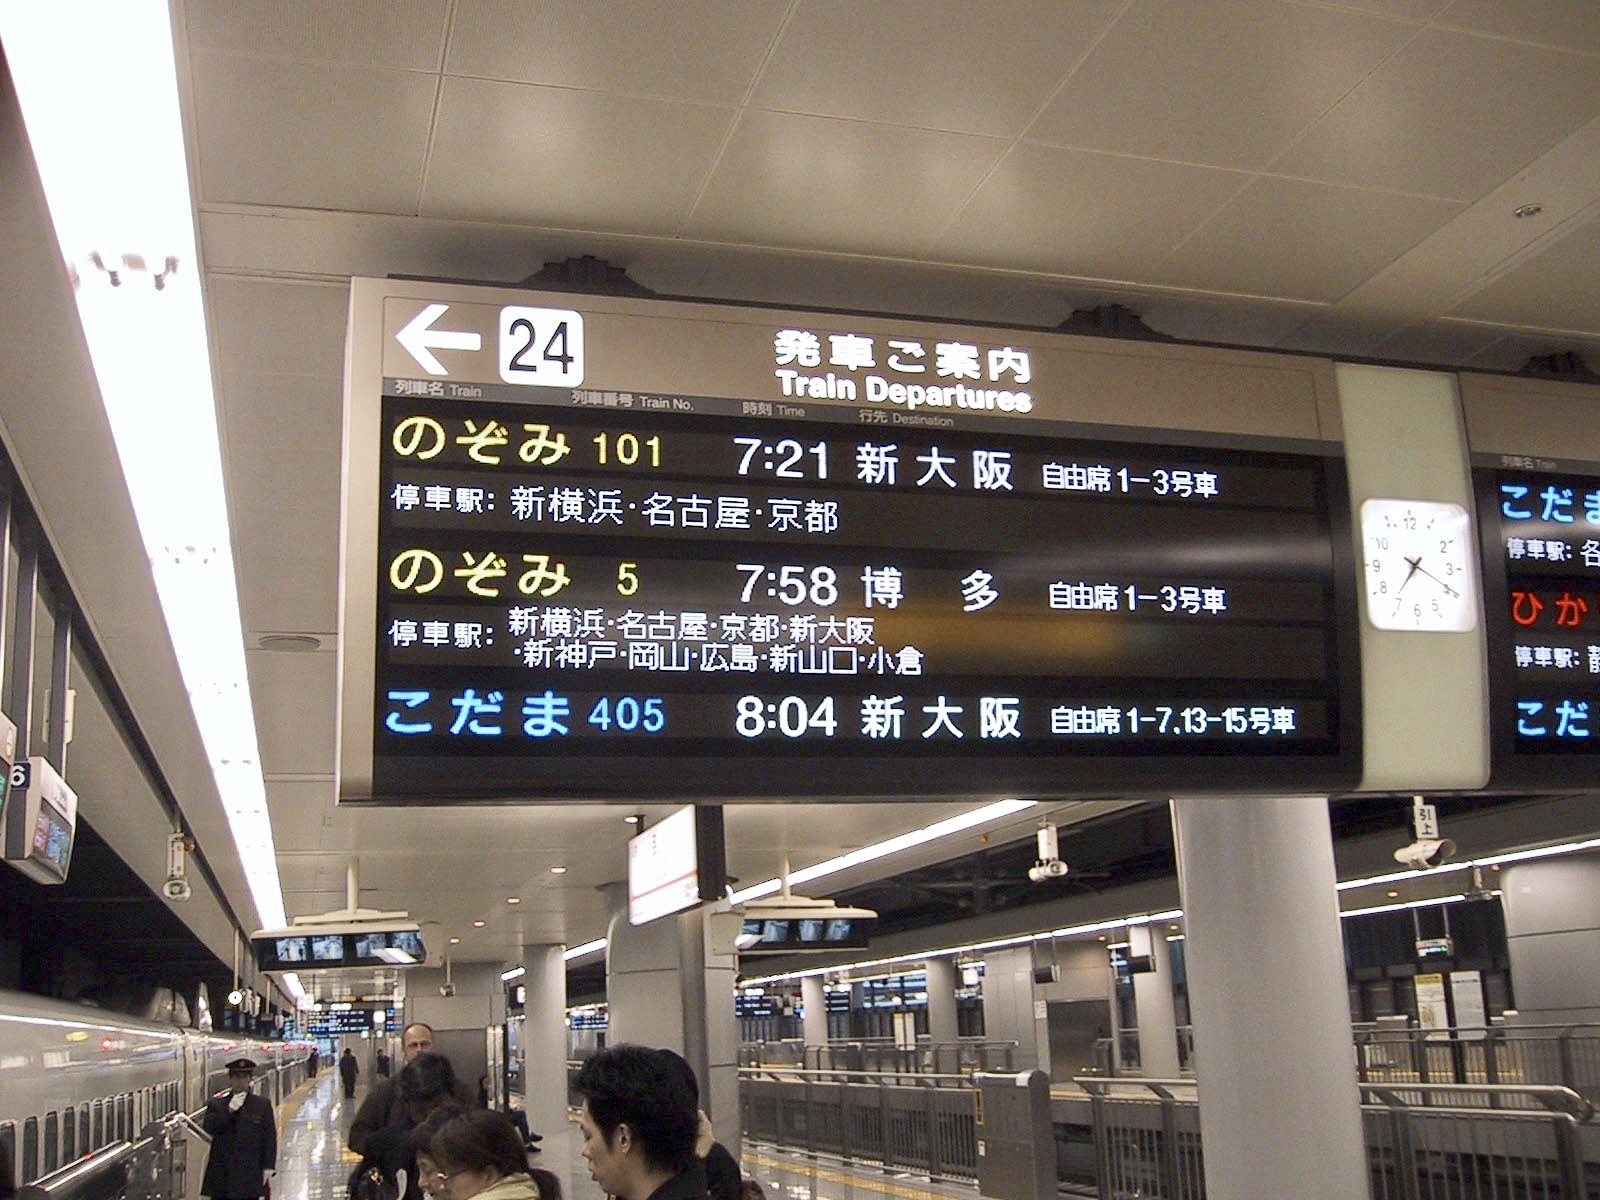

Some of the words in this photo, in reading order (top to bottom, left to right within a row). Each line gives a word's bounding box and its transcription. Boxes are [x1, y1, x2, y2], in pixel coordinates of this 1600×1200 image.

[509, 318, 574, 374] 24
[774, 329, 1032, 384] 発車ご案内
[394, 379, 445, 397] 列車名
[450, 383, 482, 398] Train
[570, 389, 634, 407] 列車番号
[639, 395, 670, 409] Train
[673, 397, 695, 411] No.
[774, 369, 857, 400] Train
[864, 375, 1033, 414] Departures
[776, 404, 806, 418] Time
[858, 408, 889, 424] 行先
[892, 412, 955, 427] Destination
[391, 415, 571, 466] のぞみ
[592, 431, 662, 467] 101
[732, 436, 828, 480] 7:21
[855, 442, 1014, 491] 新大阪
[389, 549, 571, 598] のぞみ
[616, 562, 640, 596] 5
[735, 563, 839, 606] 7:58
[860, 565, 1000, 613] 博多
[1511, 592, 1600, 626] ひか
[386, 688, 570, 737] こだま
[588, 697, 665, 732] 405
[735, 694, 838, 738] 8:04
[860, 694, 1022, 740] 新大阪
[1517, 700, 1600, 737] こだ
